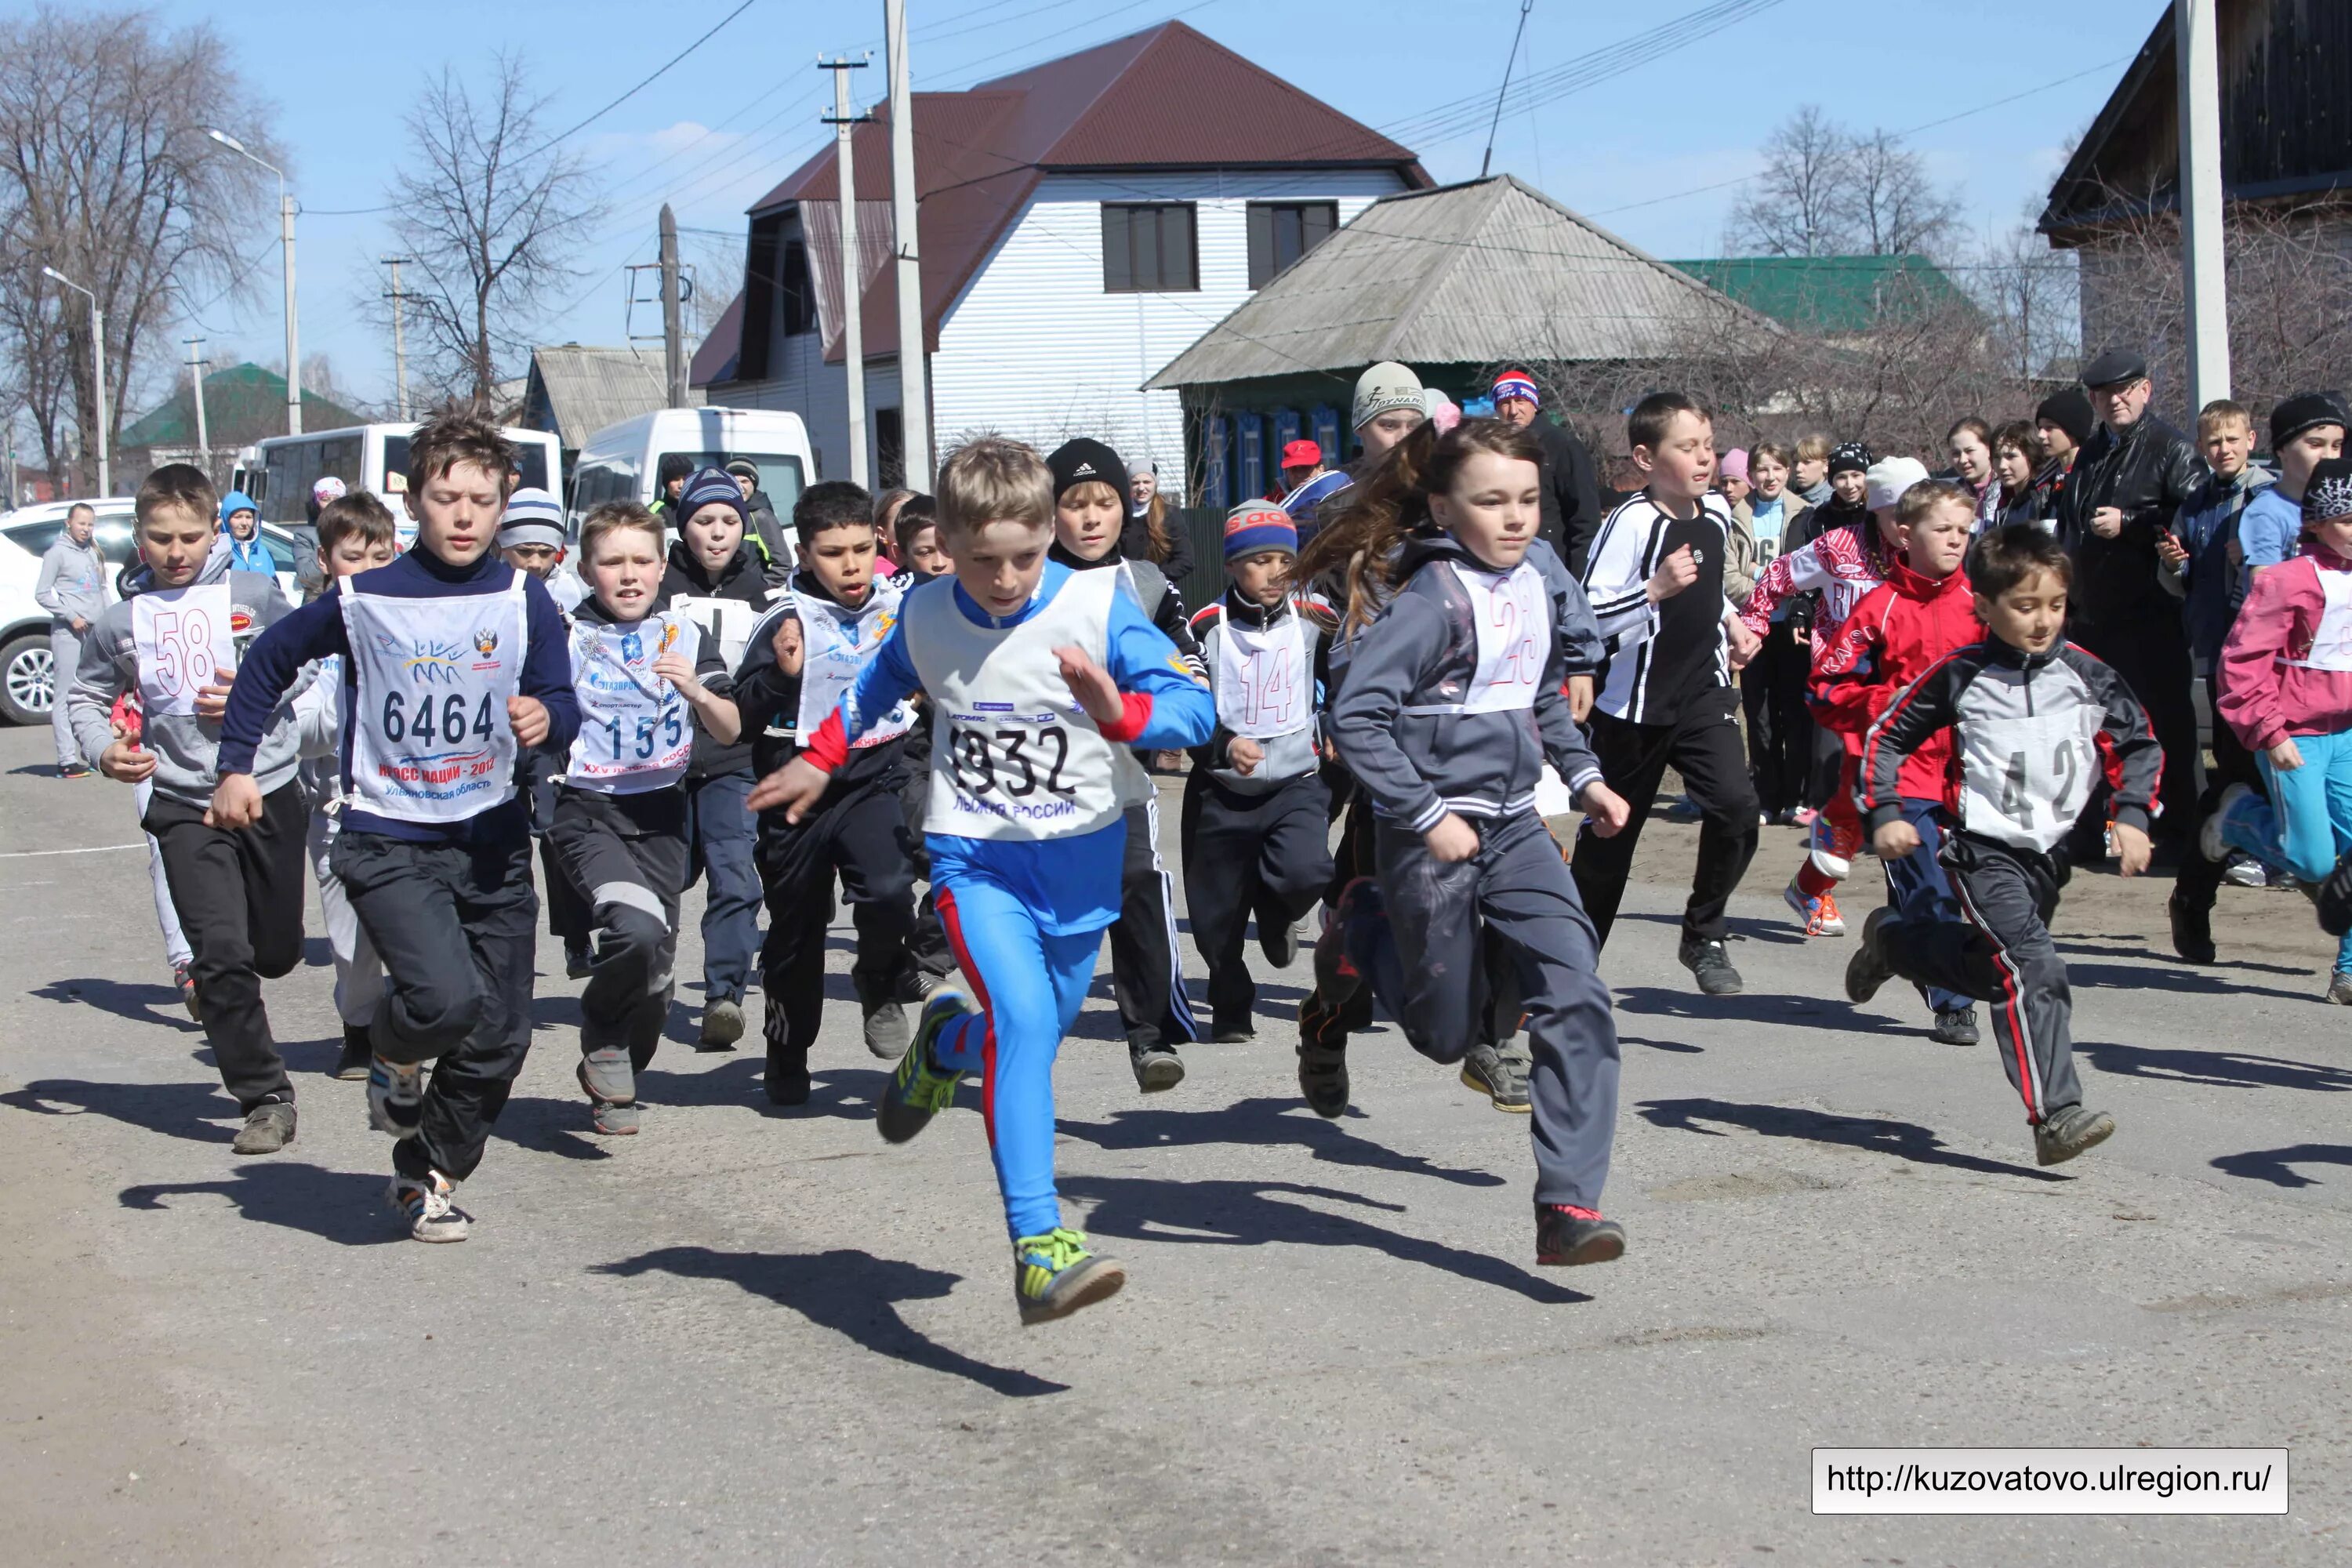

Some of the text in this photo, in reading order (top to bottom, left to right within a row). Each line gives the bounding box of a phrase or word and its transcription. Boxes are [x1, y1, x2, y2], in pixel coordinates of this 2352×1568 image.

[154, 608, 216, 697] 58
[1240, 648, 1291, 724] 14
[383, 691, 494, 747] 6464
[605, 705, 682, 760] 155
[385, 779, 492, 800] Ульяновская область
[422, 765, 460, 784] НАЦИИ
[470, 757, 495, 776] 2012
[949, 726, 1076, 797] 1932
[2002, 739, 2076, 830] 42
